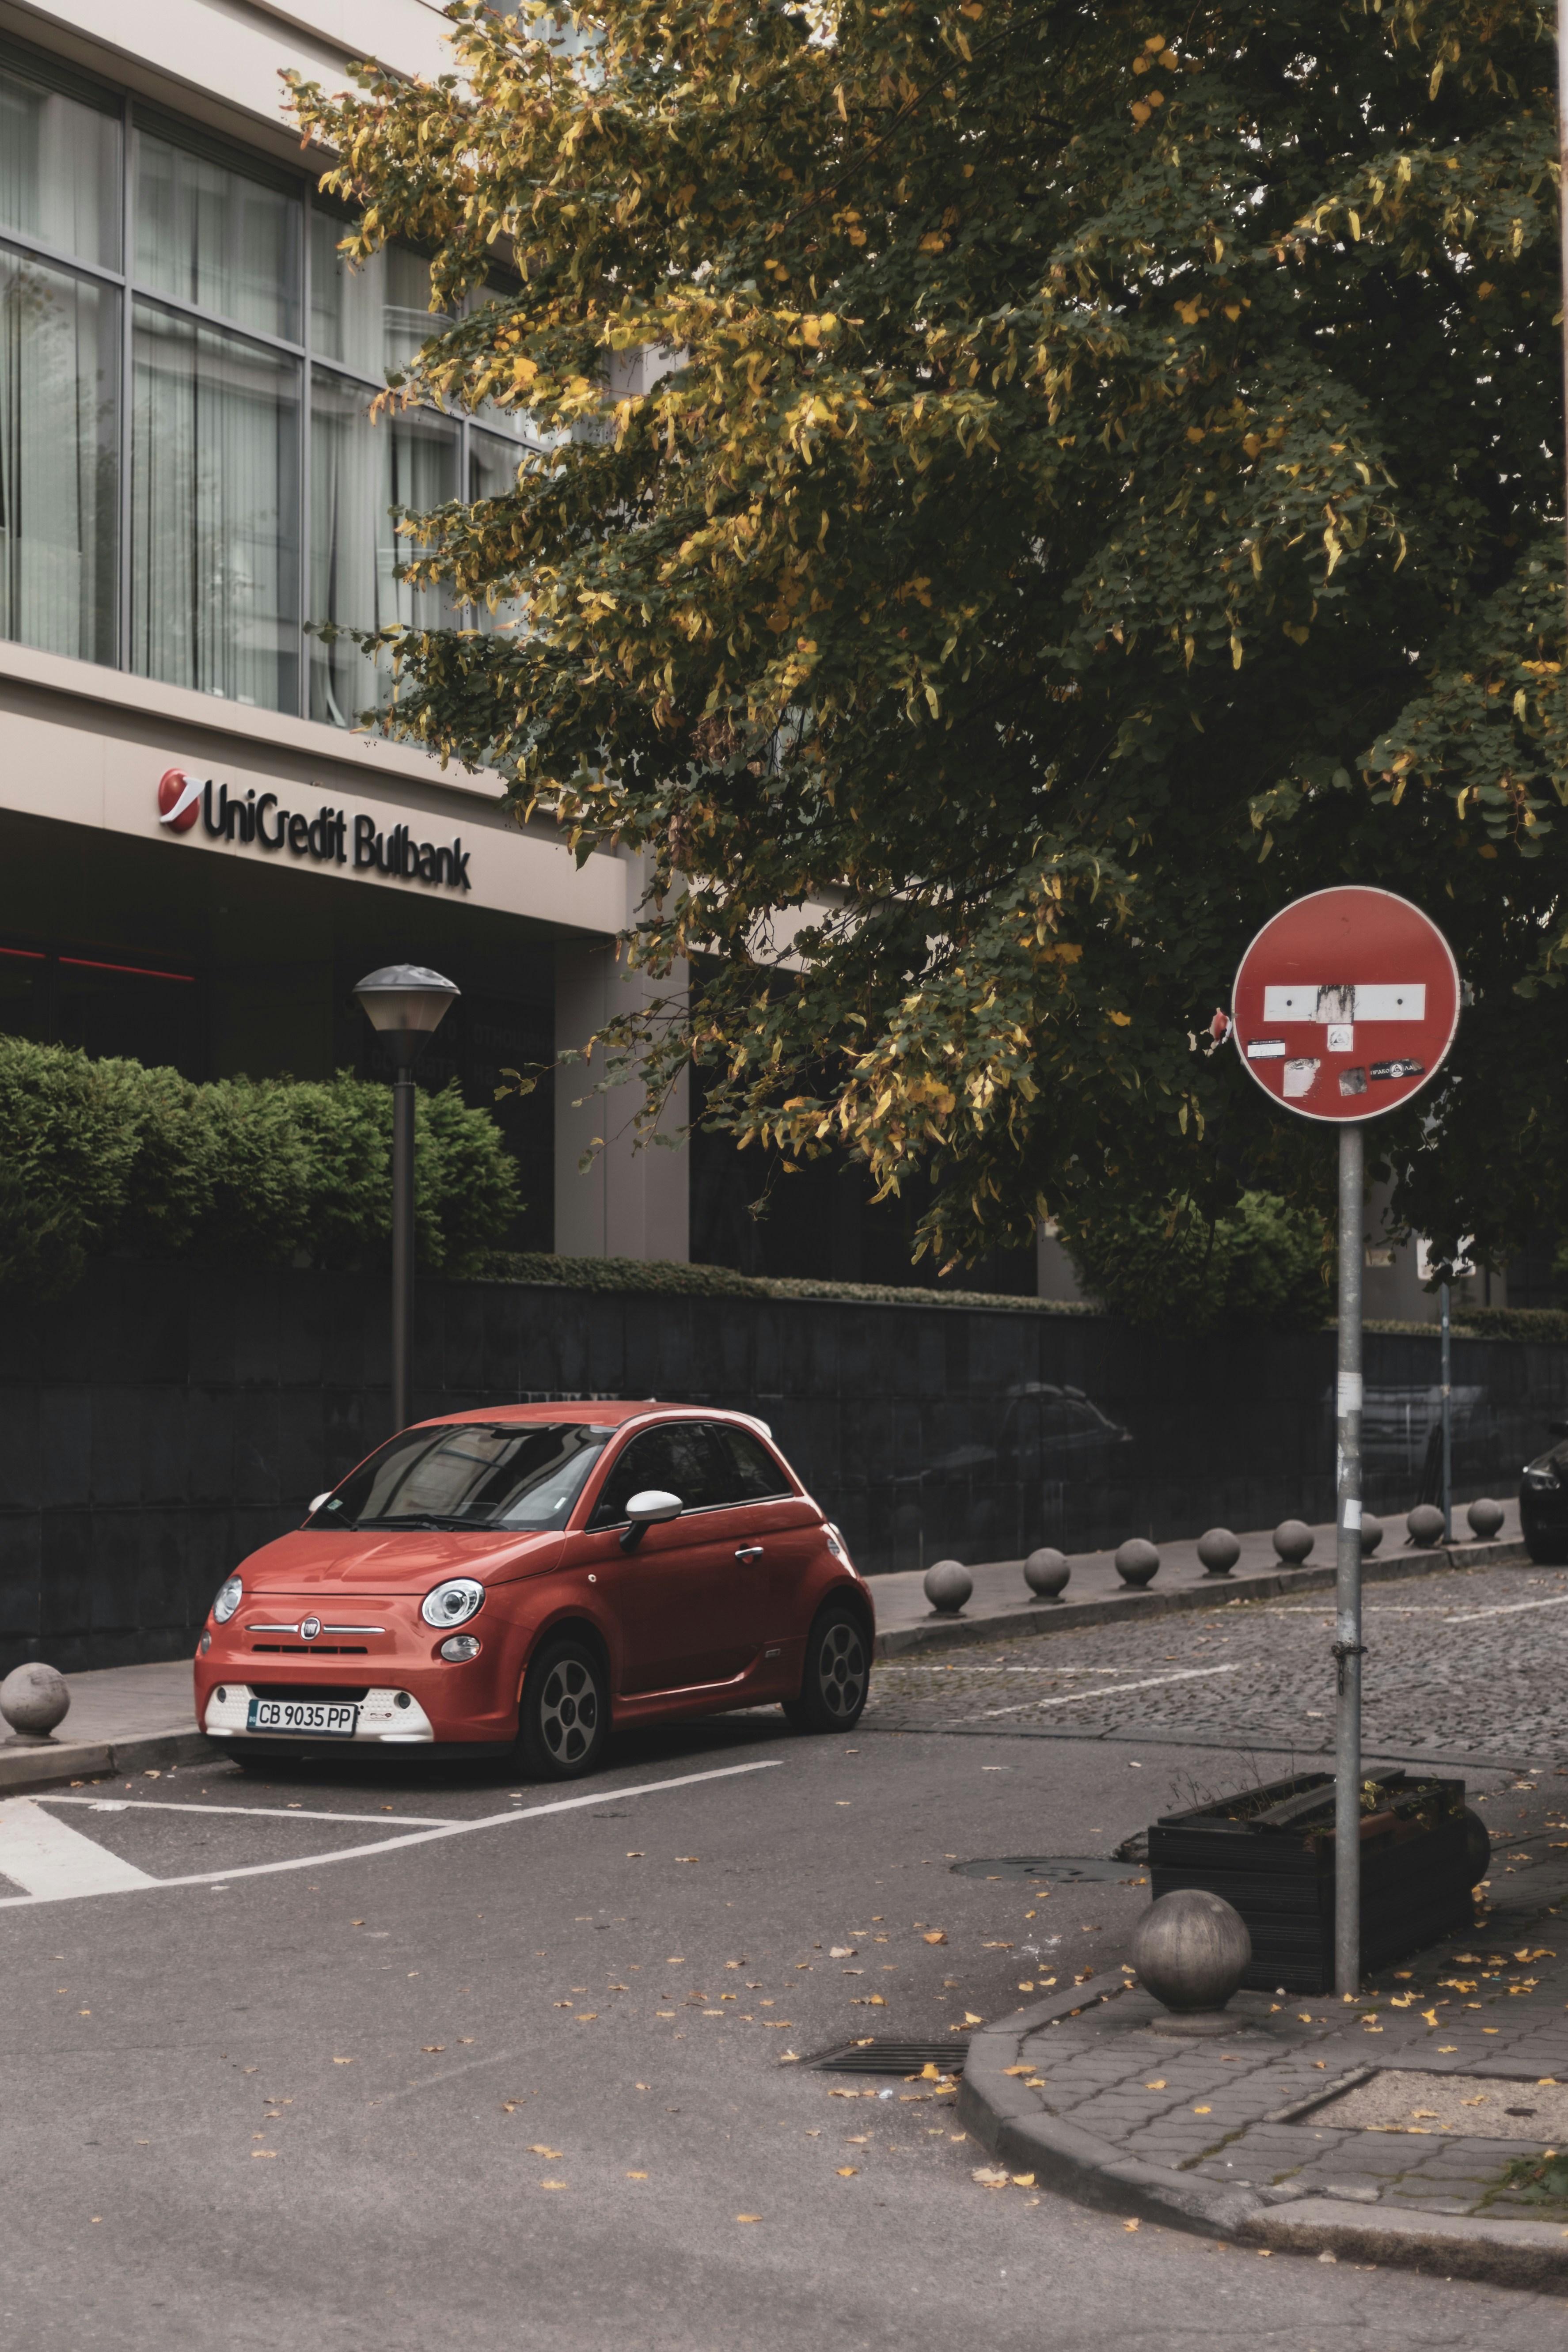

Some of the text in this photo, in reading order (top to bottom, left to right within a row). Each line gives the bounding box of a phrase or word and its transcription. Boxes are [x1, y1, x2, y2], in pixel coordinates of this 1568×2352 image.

[204, 779, 471, 889] UniCredit Bulbank
[259, 1704, 351, 1728] CB 9035 PP
